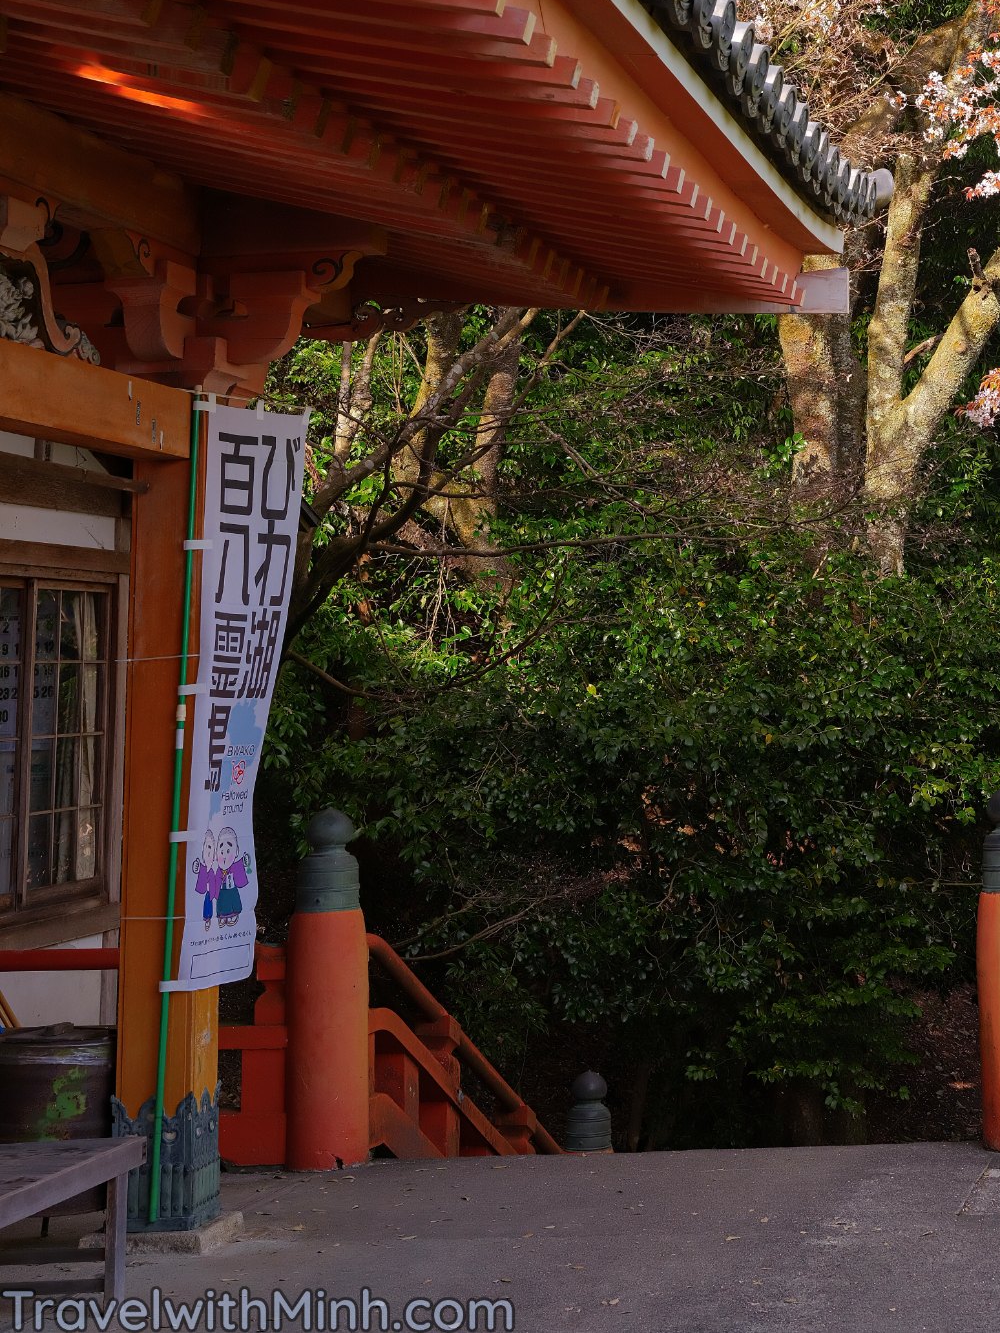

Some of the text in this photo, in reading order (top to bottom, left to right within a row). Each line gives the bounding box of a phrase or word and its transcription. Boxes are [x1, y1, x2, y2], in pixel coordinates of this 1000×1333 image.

[205, 432, 258, 792] 百八霊場
[237, 435, 300, 699] びわ湖
[222, 802, 244, 815] ground
